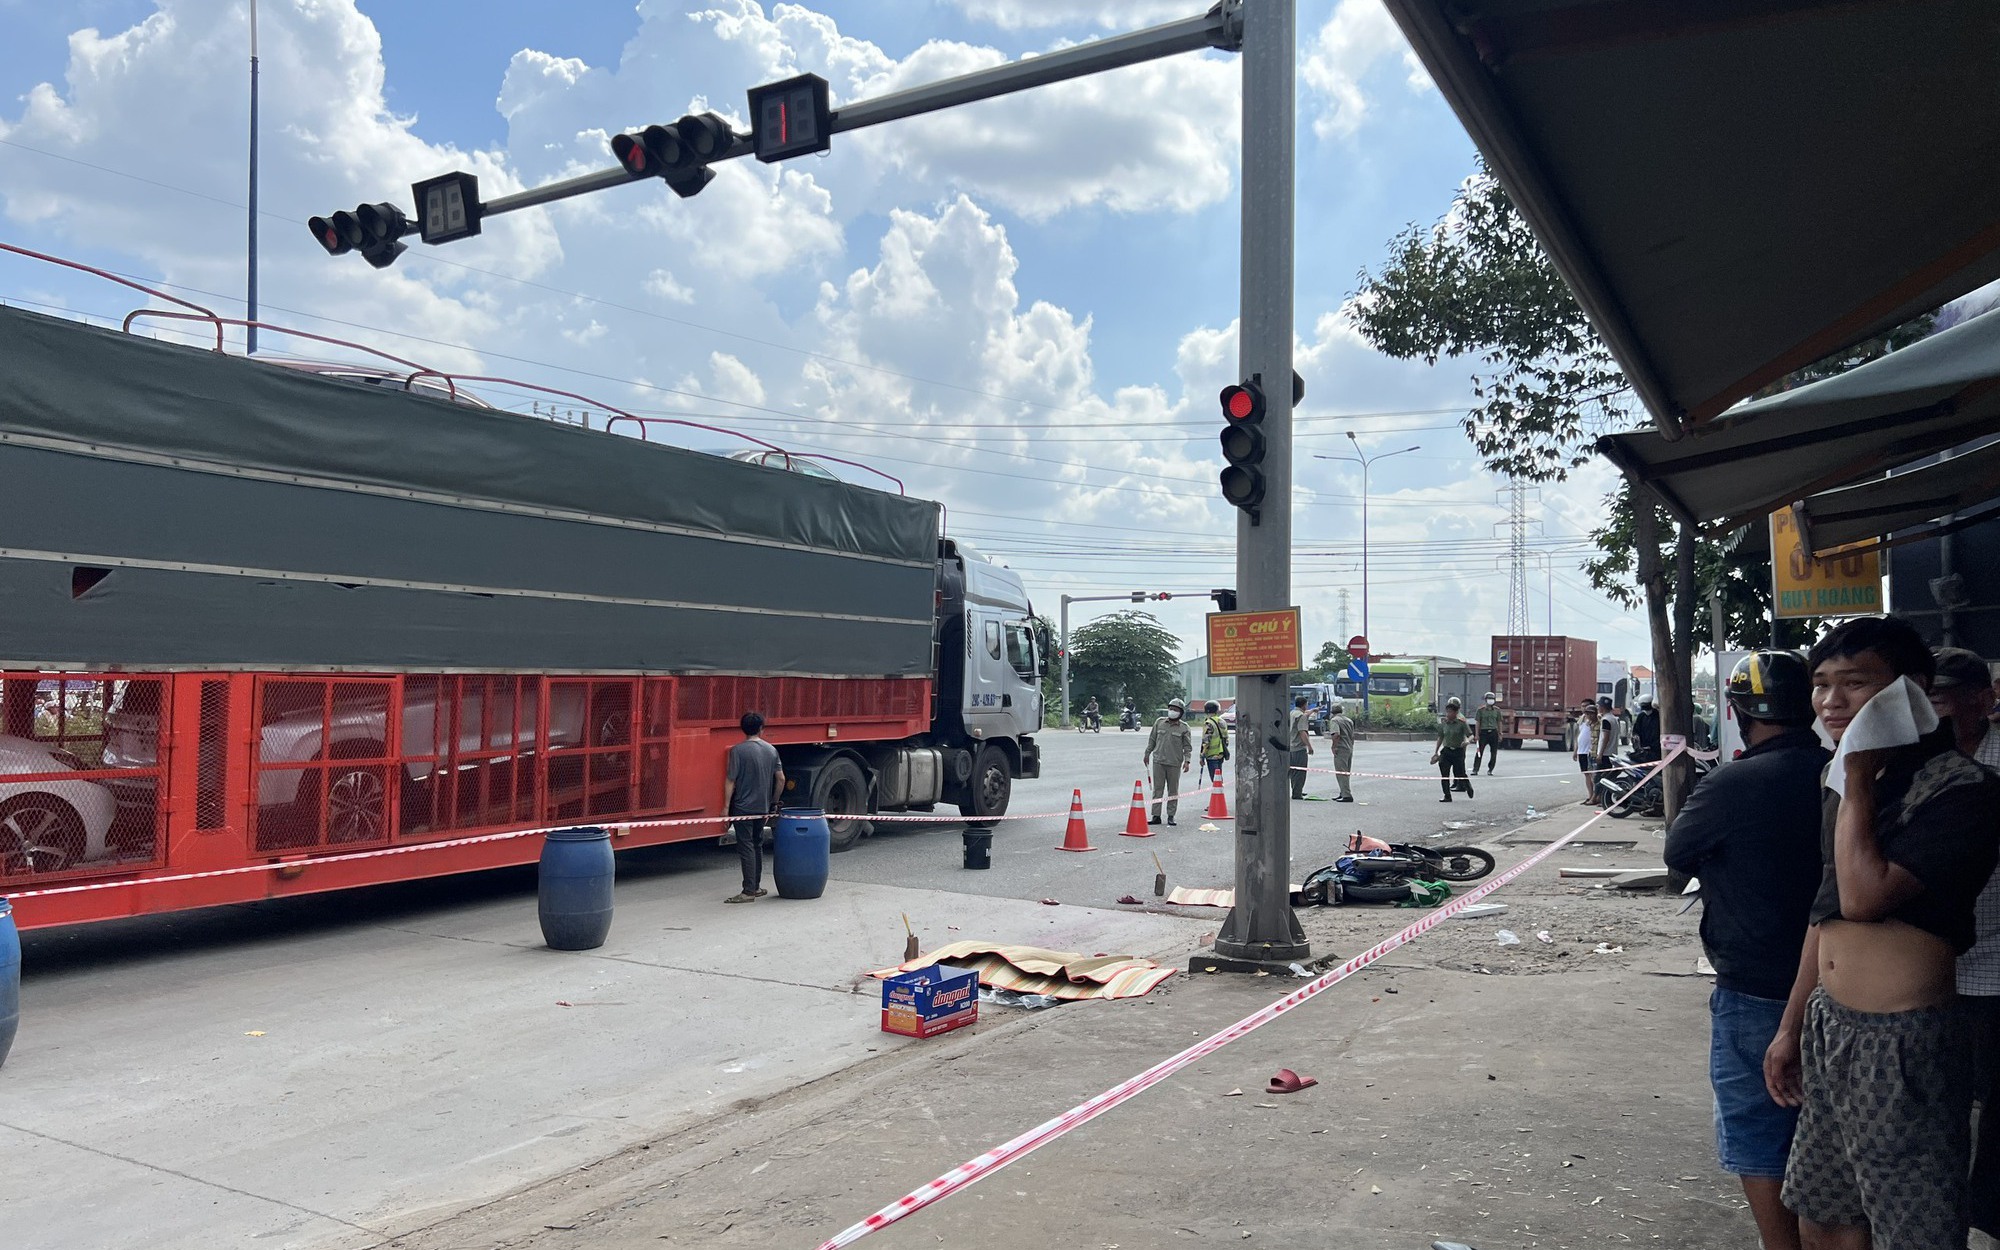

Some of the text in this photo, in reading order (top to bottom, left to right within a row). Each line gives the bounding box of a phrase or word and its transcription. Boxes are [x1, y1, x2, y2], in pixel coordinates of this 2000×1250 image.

[1781, 589, 1812, 609] HUY
[1249, 618, 1278, 633] CHÚ
[1282, 617, 1291, 631] Ý
